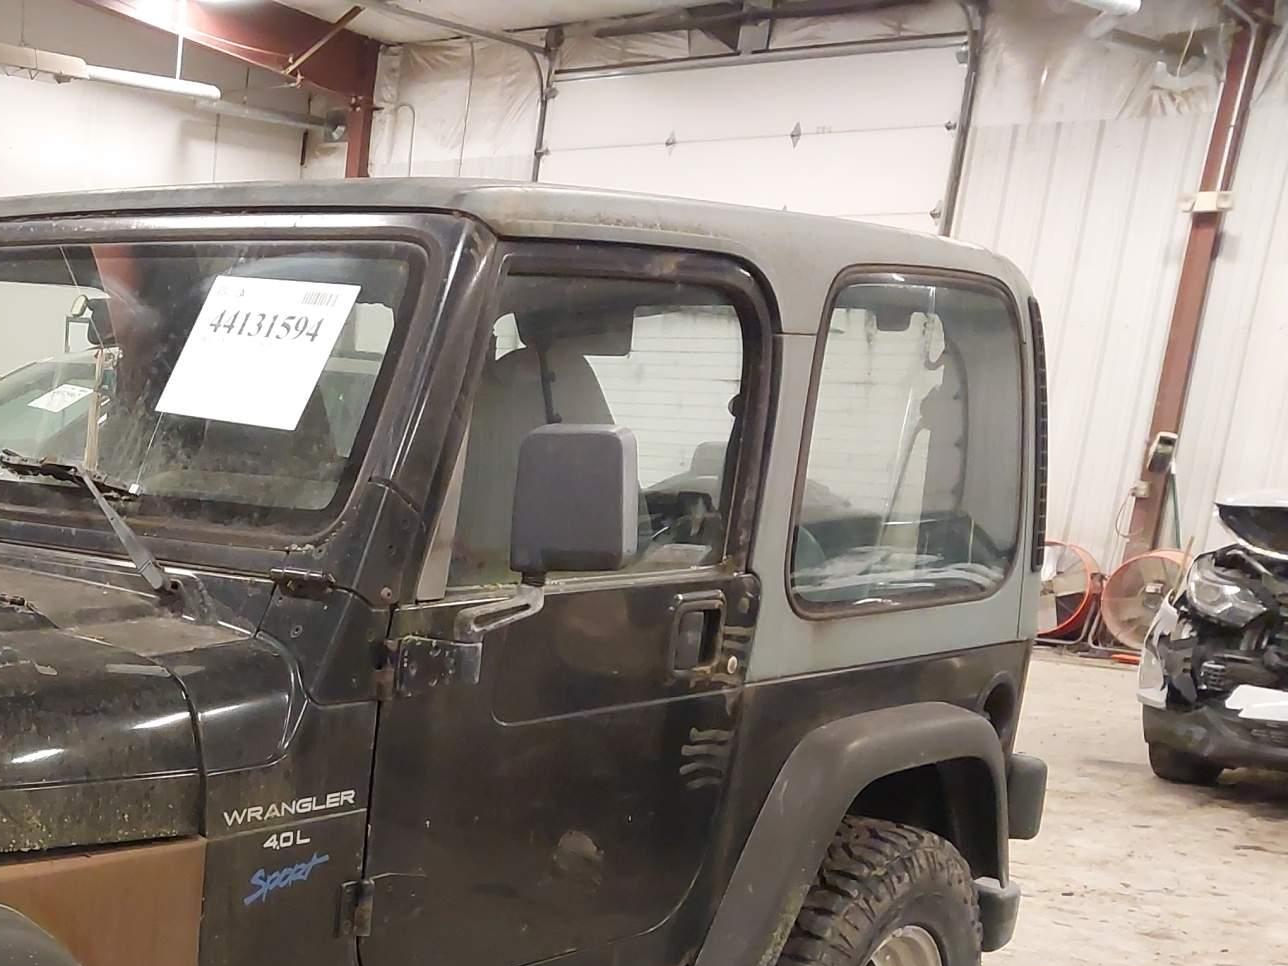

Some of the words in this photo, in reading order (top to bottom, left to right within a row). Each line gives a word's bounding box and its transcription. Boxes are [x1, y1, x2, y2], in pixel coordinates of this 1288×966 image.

[209, 309, 325, 342] 44131594
[223, 789, 356, 827] WRANGLER
[244, 852, 330, 906] Sport
